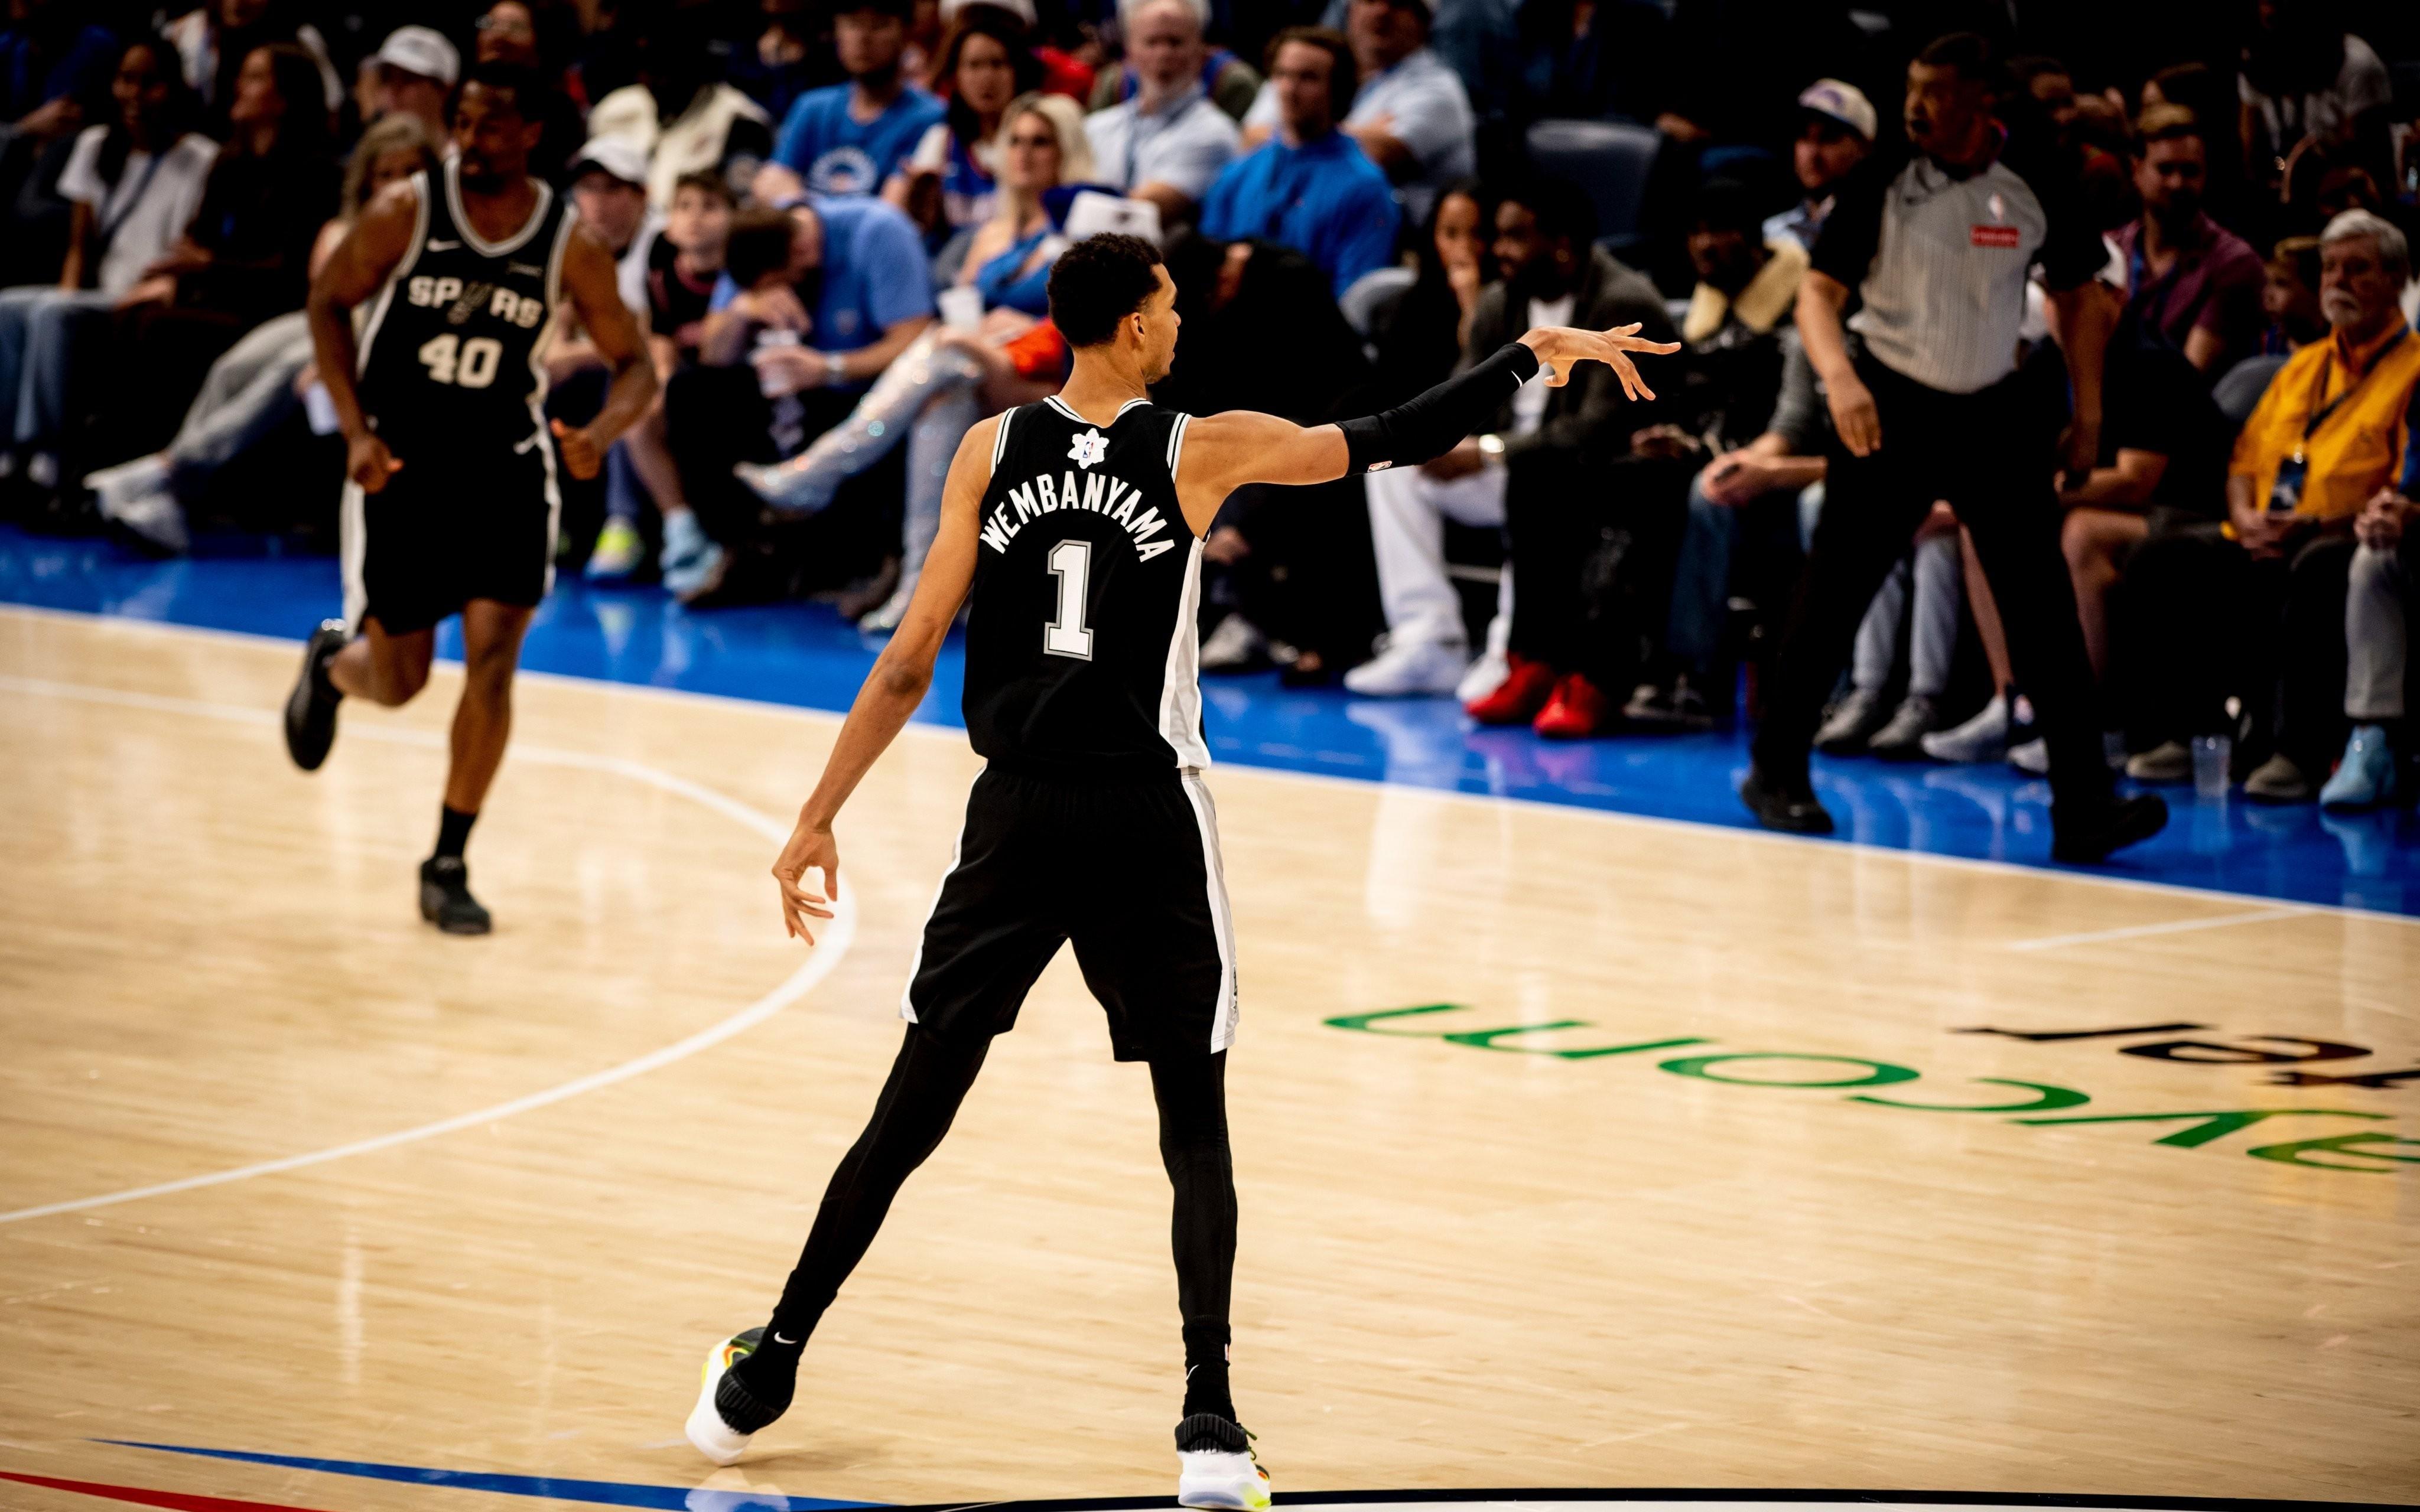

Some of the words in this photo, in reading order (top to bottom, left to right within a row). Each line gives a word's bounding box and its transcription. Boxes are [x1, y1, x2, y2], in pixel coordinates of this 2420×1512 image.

[418, 333, 503, 389] 40
[980, 471, 1175, 563] WEMBANYAMA
[1044, 539, 1094, 662] 1
